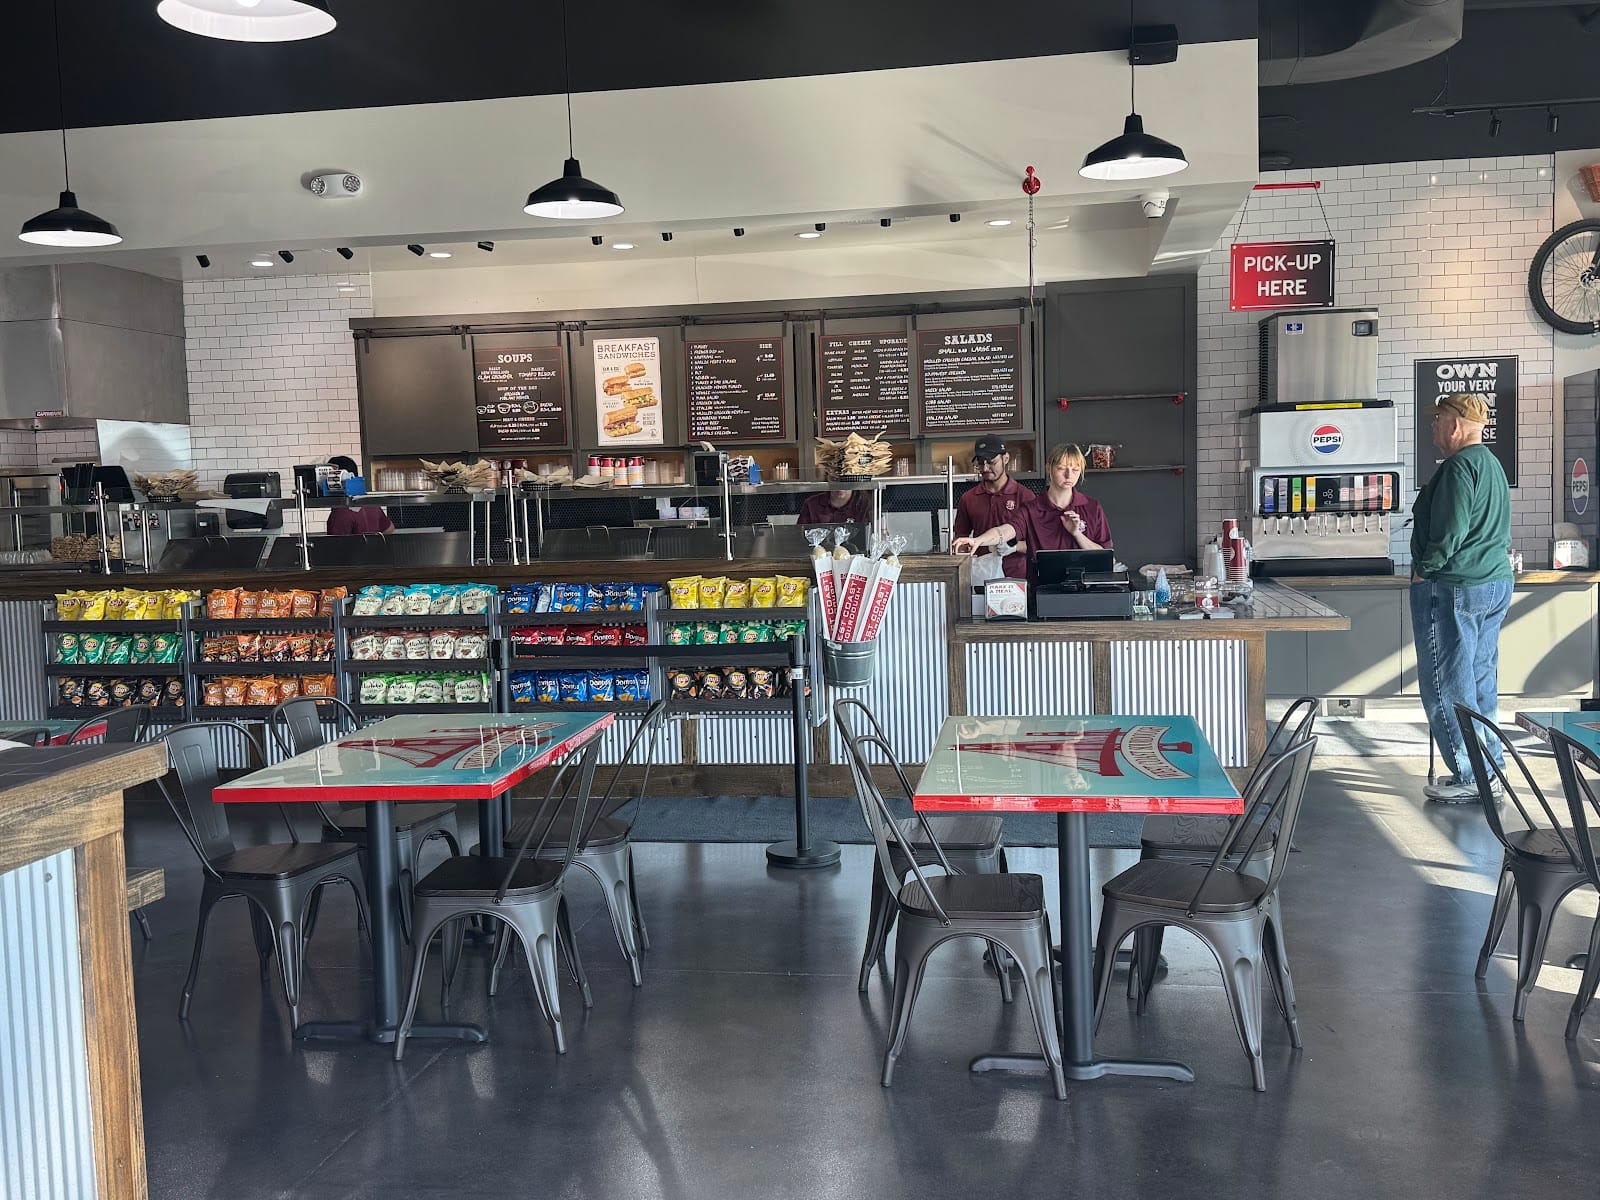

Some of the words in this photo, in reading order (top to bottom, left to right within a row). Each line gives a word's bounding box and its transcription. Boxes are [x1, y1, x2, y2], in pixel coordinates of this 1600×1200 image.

[1243, 253, 1322, 273] PICK-UP
[1256, 279, 1308, 297] HERE
[944, 333, 993, 345] SALADS
[597, 343, 656, 353] BREAKFAST
[497, 353, 533, 364] SOUPS
[597, 351, 656, 360] SANDWICHES
[1436, 362, 1498, 380] OWN
[1437, 381, 1466, 393] YOUR
[1468, 379, 1497, 391] VERY
[1313, 436, 1342, 444] PEPSI
[1572, 480, 1589, 494] PEPSI
[294, 595, 311, 605] Sun
[822, 579, 835, 615] COAST
[212, 598, 227, 609] Sun
[261, 598, 276, 608] Sun
[870, 586, 887, 622] COAST
[836, 621, 847, 641] EST
[842, 581, 858, 618] COAST
[282, 683, 297, 694] Sun
[307, 684, 322, 693] Sun
[510, 681, 531, 690] Doritos
[589, 679, 611, 687] Doritos
